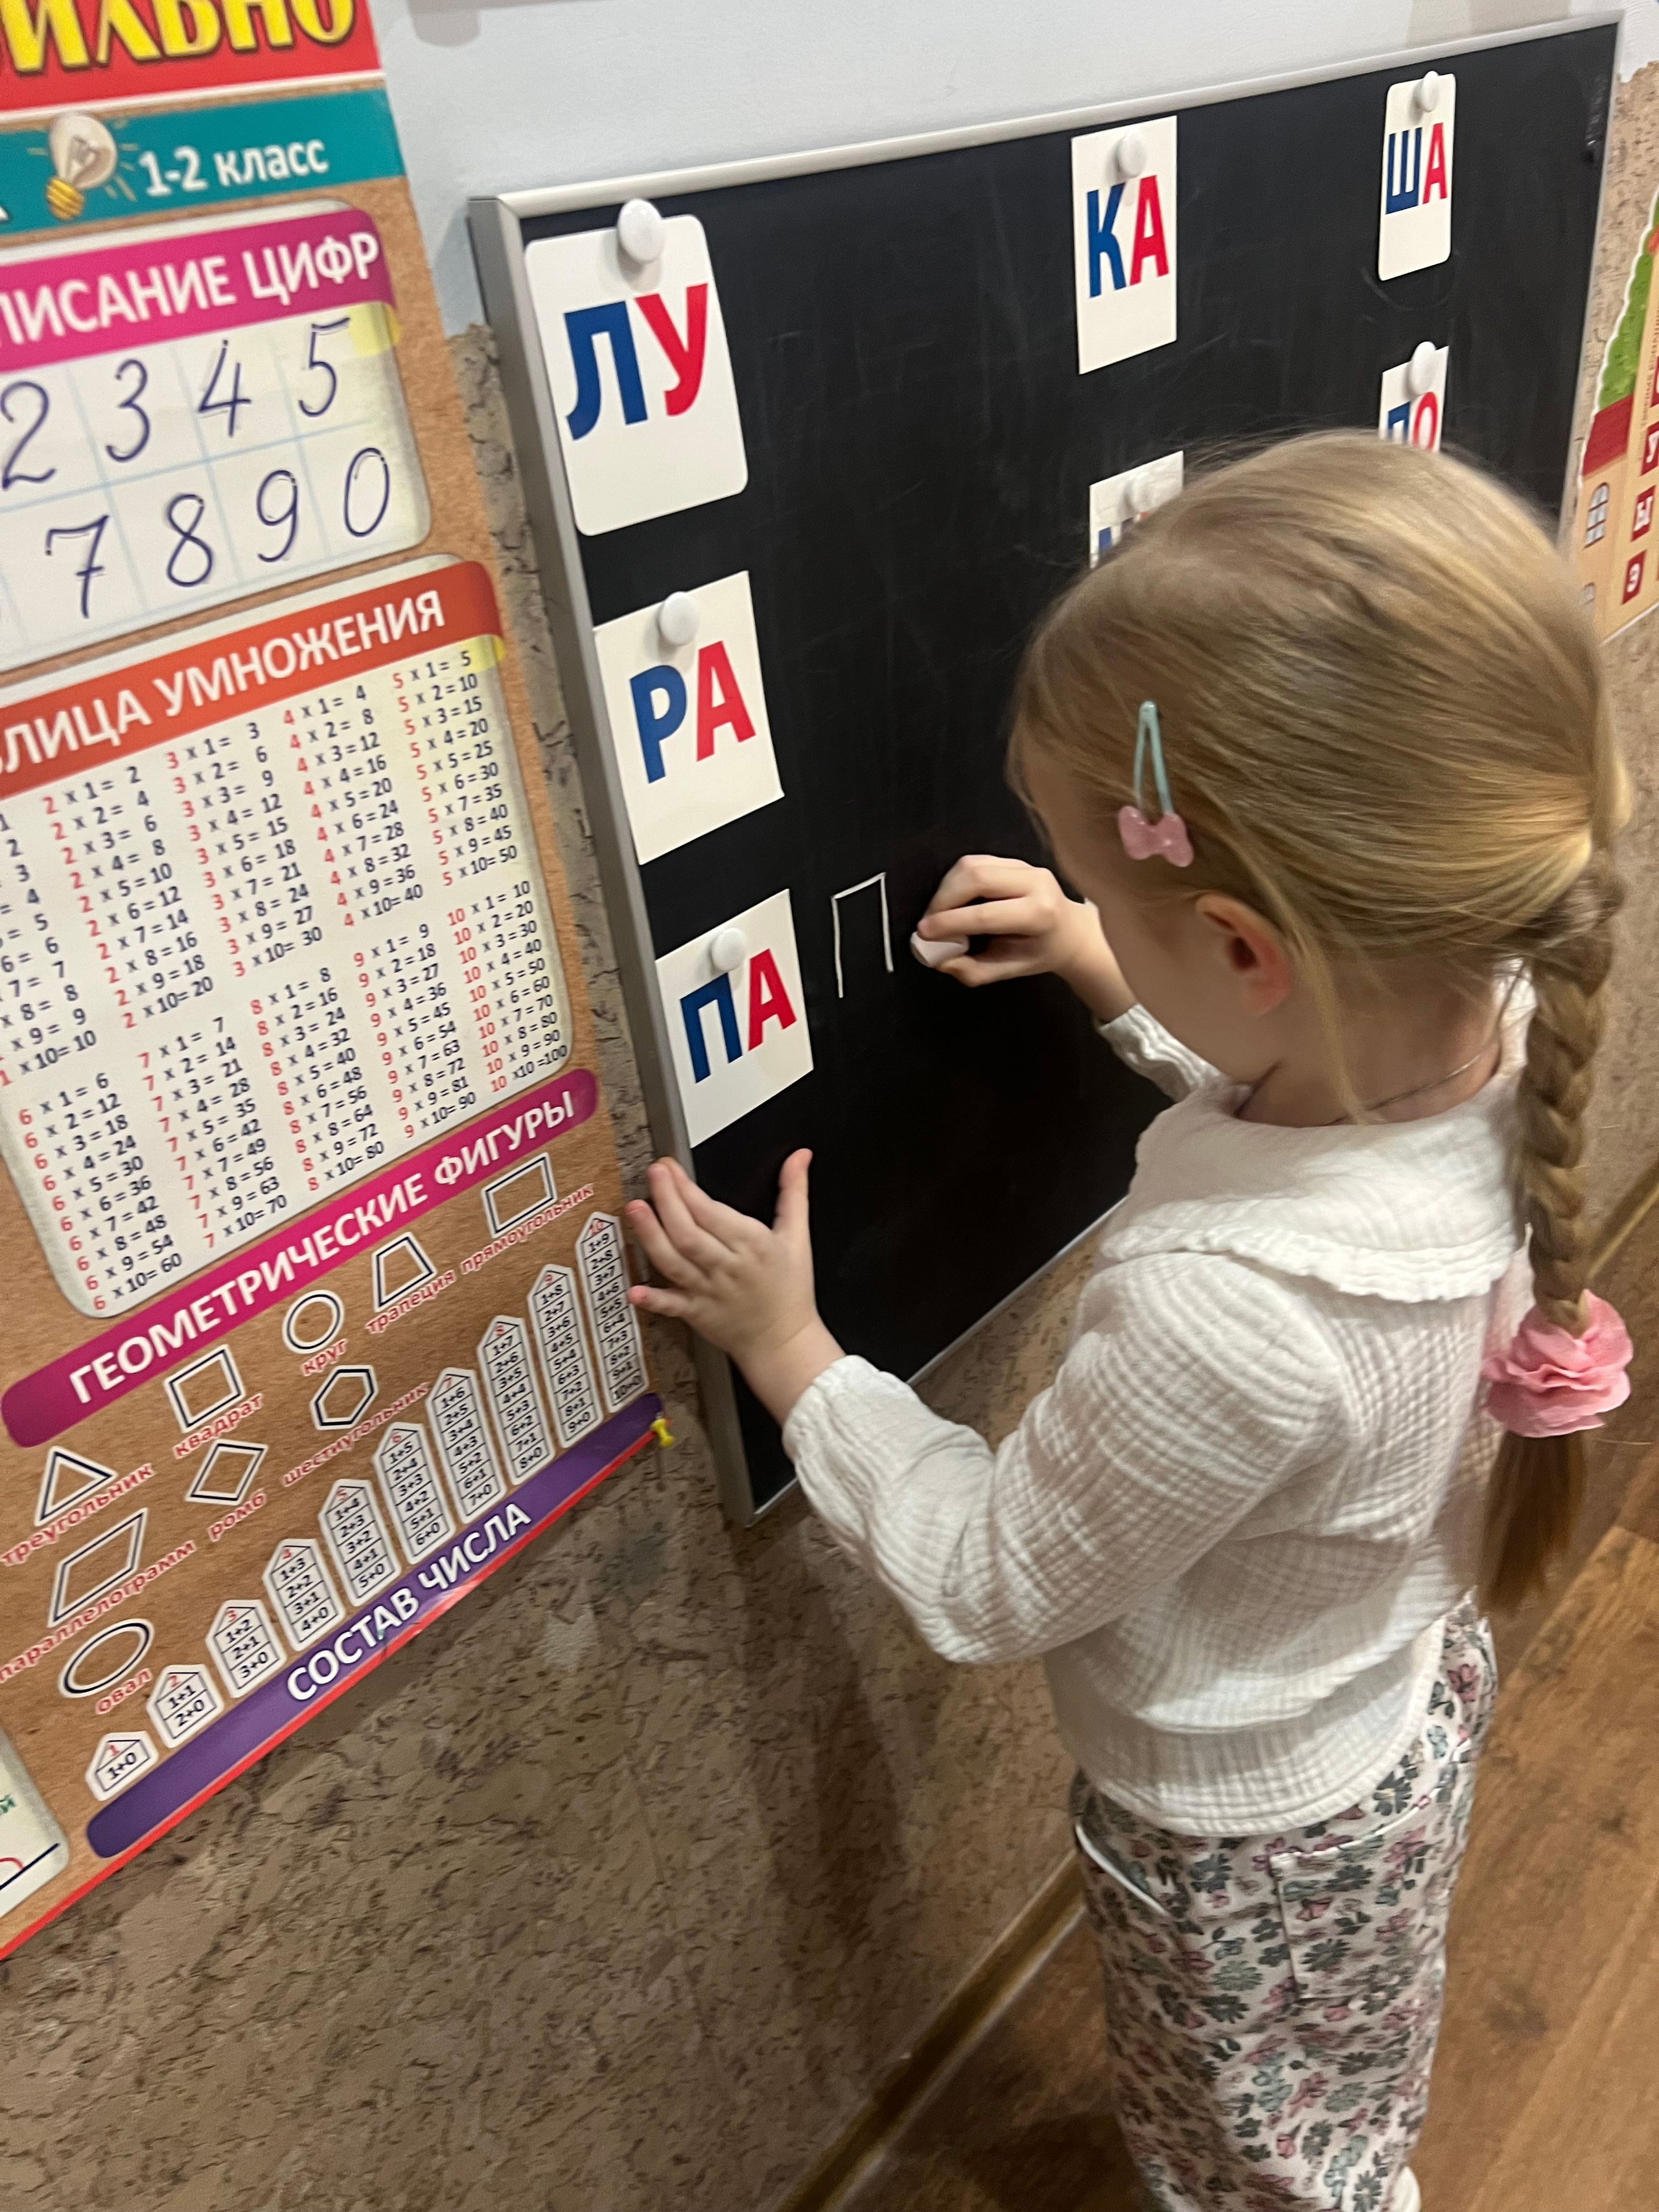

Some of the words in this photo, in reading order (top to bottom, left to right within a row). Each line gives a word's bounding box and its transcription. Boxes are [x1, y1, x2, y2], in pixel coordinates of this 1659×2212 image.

[139, 146, 208, 196] 1-2
[214, 139, 329, 187] класс
[1385, 122, 1448, 215] ША
[241, 231, 380, 306] ЦИФР
[1086, 174, 1169, 299] КА
[104, 358, 151, 463] 3
[197, 339, 252, 438] 4
[298, 317, 351, 418] 5
[563, 283, 708, 441] ЛУ
[45, 515, 111, 619] 7
[166, 493, 215, 588] 8
[256, 469, 299, 563] 9
[343, 447, 390, 538] 0
[0, 688, 153, 774] ЛИЦА
[153, 589, 447, 717] УМНОЖЕНИЯ
[629, 641, 756, 784] РА
[680, 948, 797, 1084] ПА
[69, 1172, 428, 1404] ГЕОМЕТРИЧЕСКИЕ
[434, 1091, 575, 1185] ФИГУРЫ
[461, 1184, 594, 1274] прямоугольник
[366, 1270, 456, 1333] трапеция
[303, 1340, 347, 1375] круг
[175, 1395, 262, 1458] квадрат
[284, 1384, 428, 1485] шестиугольник
[4, 1464, 153, 1565] треугольник
[209, 1491, 266, 1541] ромб
[0, 1541, 196, 1681] параллелограмм
[287, 1589, 419, 1701] СОСТАВ
[419, 1504, 531, 1590] ЧИСЛА
[97, 1669, 152, 1713] овал
